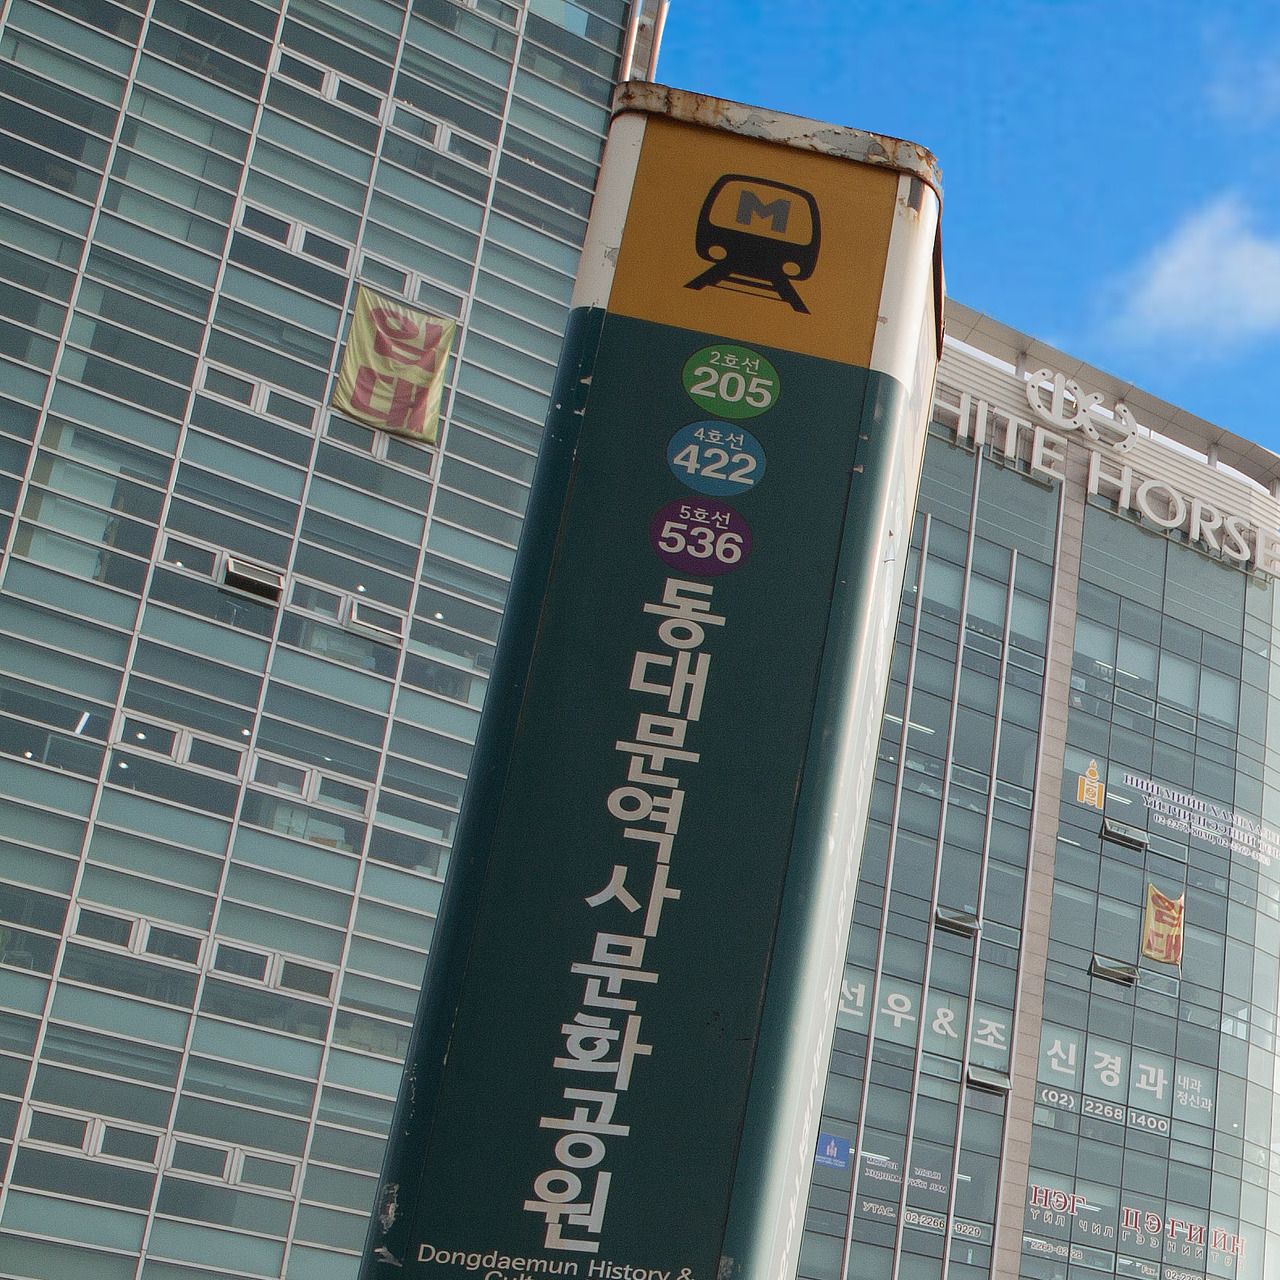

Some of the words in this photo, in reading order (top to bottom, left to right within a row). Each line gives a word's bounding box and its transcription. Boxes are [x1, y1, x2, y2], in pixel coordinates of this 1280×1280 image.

[709, 350, 761, 377] 2호선
[688, 365, 775, 409] 205
[694, 427, 745, 451] 4호선
[672, 445, 756, 486] 422
[679, 504, 732, 531] 5호선
[657, 523, 745, 564] 536
[522, 577, 727, 1254] 동대문역사문화공원
[1047, 1039, 1168, 1101] 신경과
[1177, 1074, 1202, 1093] 내과
[1041, 1089, 1076, 1109] (02)
[1085, 1101, 1123, 1121] 2268
[1130, 1112, 1168, 1132] 1400
[1176, 1091, 1213, 1113] 정신과
[1030, 1184, 1087, 1217] НЭГ
[417, 1243, 579, 1276] Dongdaemun
